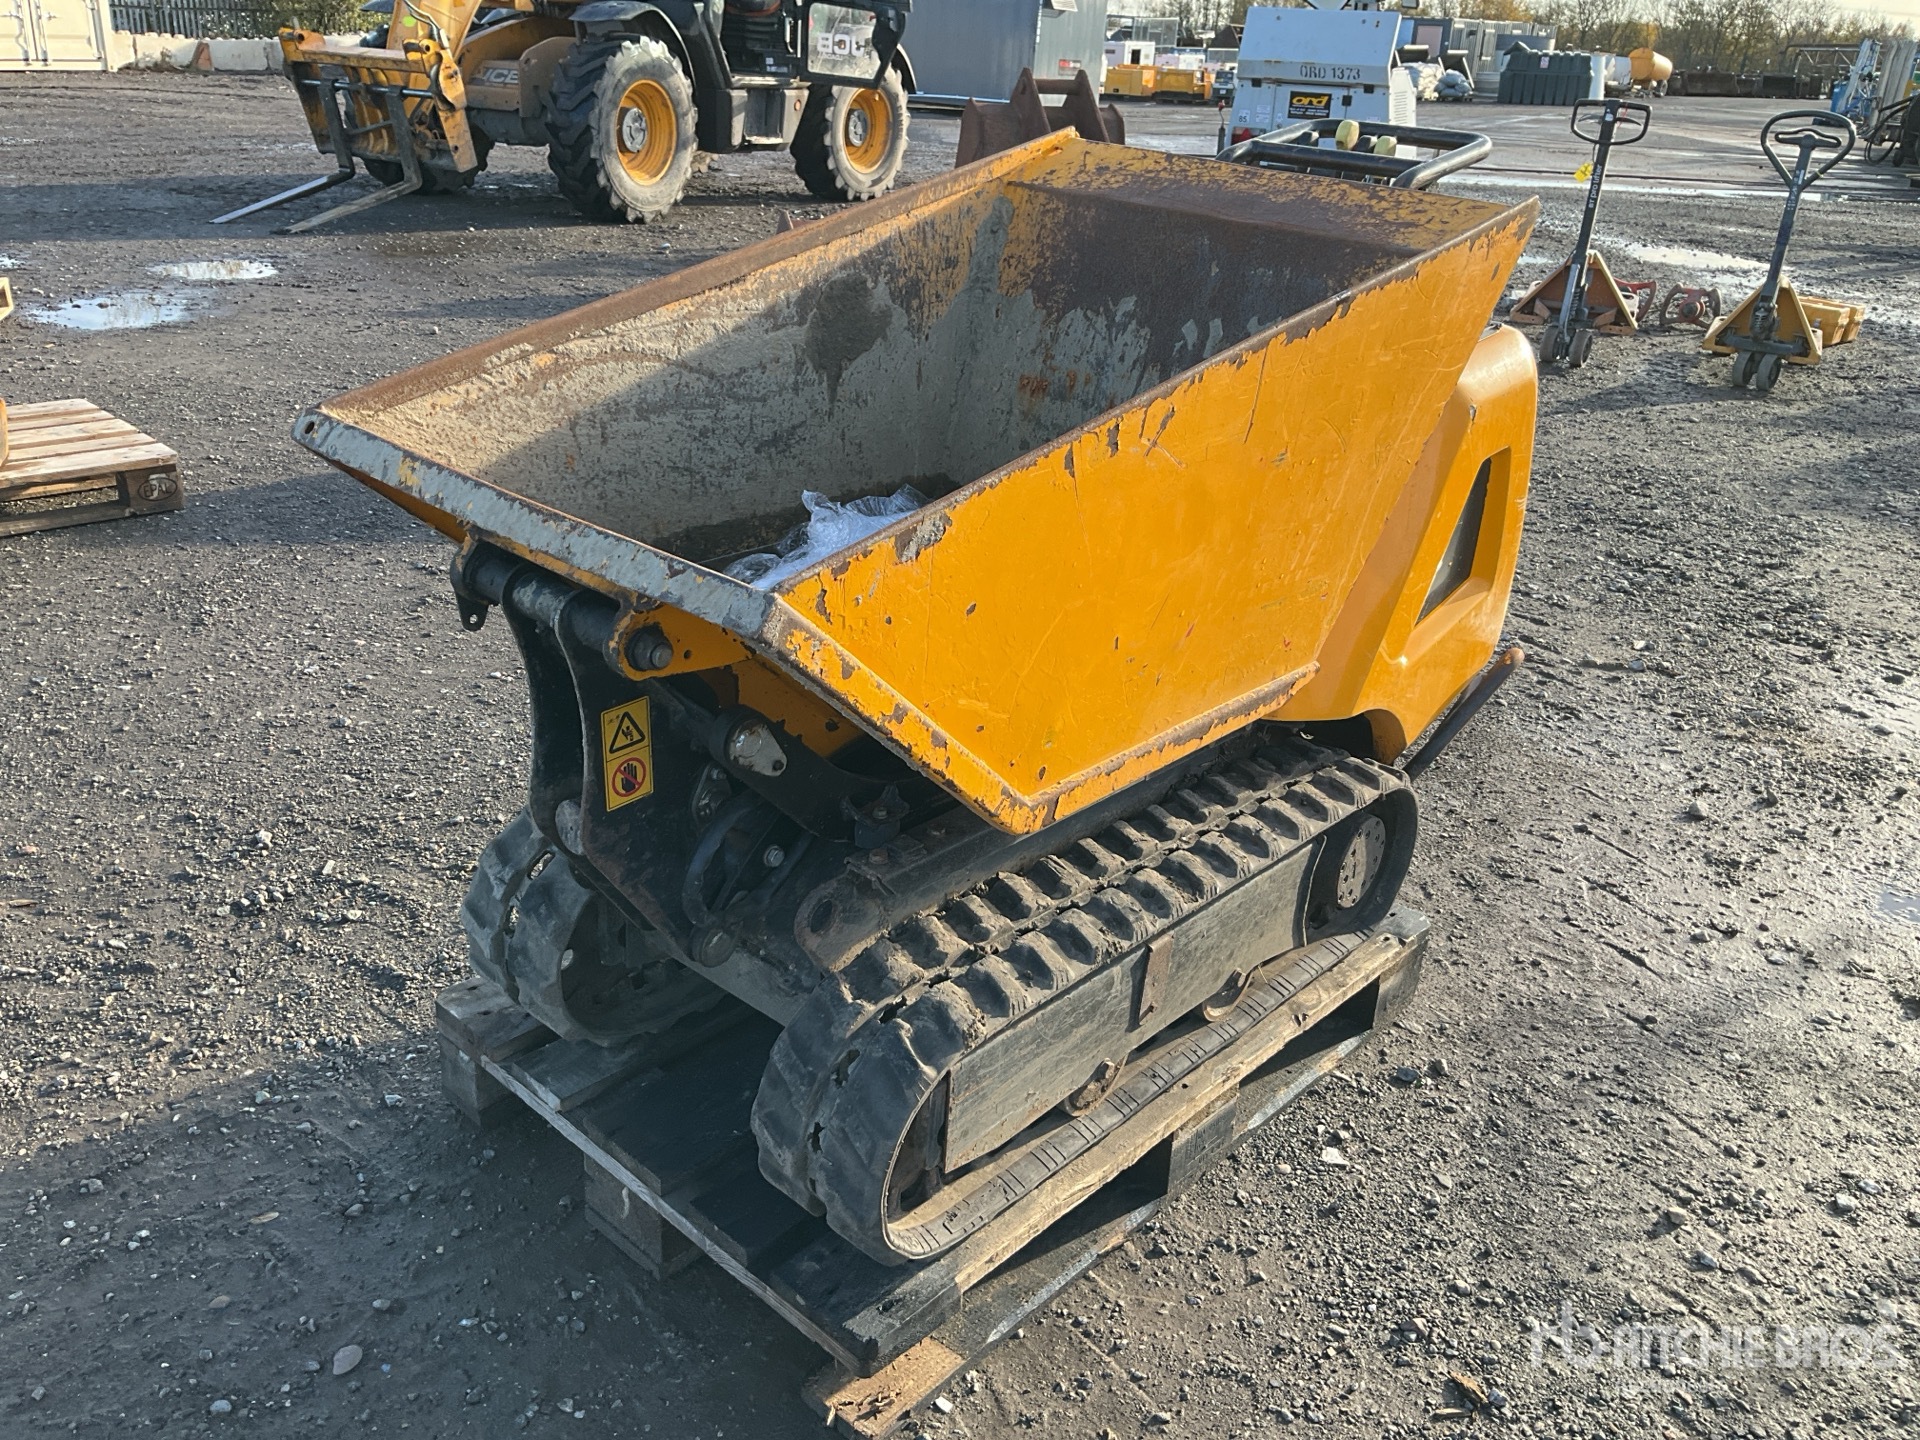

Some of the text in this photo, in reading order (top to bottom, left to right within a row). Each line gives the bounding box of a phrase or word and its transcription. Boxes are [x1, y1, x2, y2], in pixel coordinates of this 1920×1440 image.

[1300, 64, 1361, 80] ORD 1373
[1292, 95, 1329, 107] ord
[143, 483, 172, 498] EPAL
